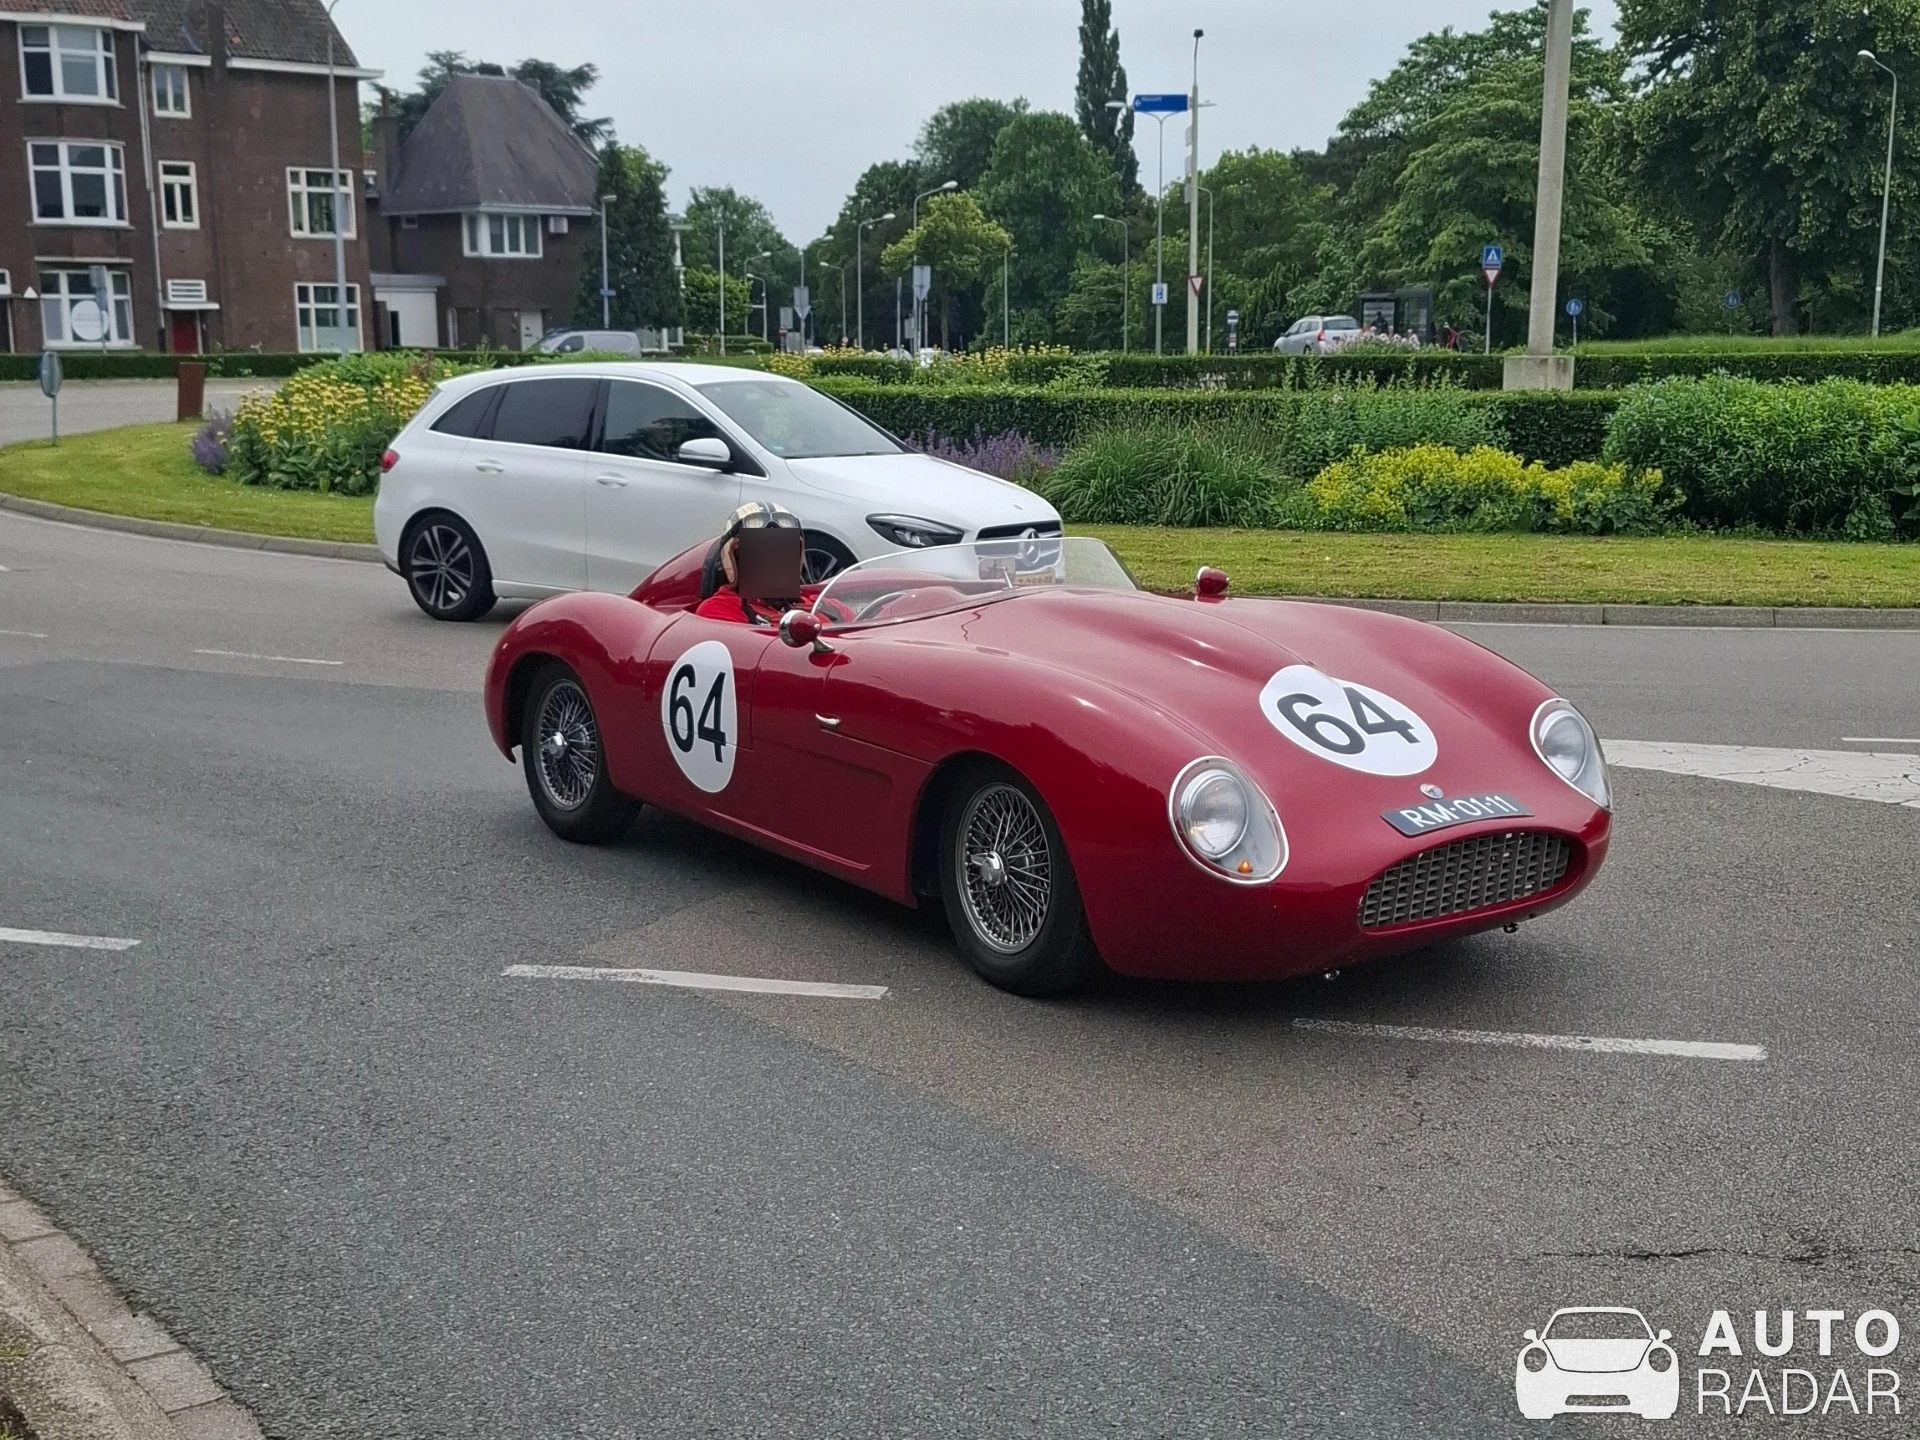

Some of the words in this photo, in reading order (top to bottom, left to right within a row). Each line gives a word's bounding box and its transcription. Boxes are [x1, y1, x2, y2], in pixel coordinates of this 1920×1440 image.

[669, 663, 726, 763] 64
[1276, 687, 1421, 755] 64
[1400, 795, 1519, 828] RM-01-11
